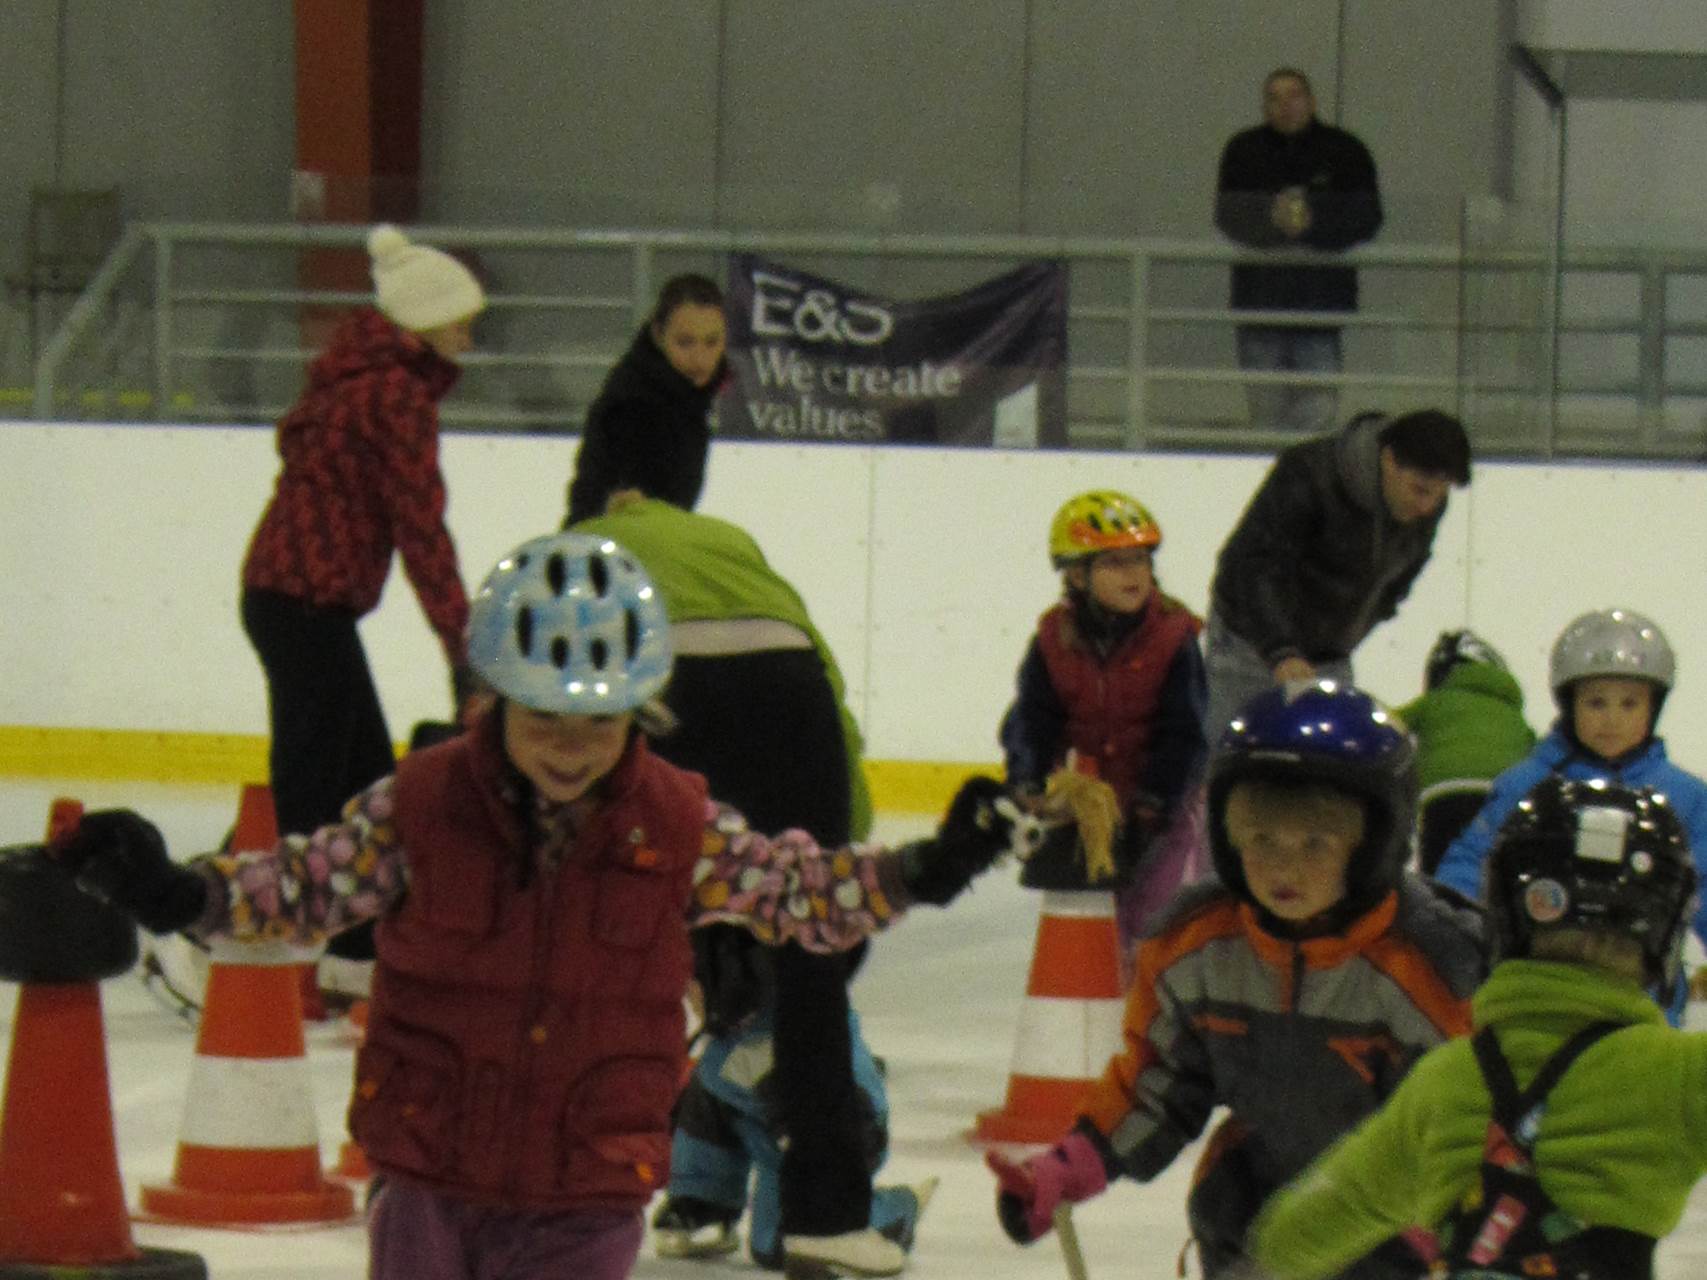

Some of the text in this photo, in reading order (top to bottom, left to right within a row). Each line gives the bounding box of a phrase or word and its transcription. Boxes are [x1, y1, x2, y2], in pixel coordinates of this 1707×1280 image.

[752, 345, 963, 397] We create
[749, 396, 884, 438] values
